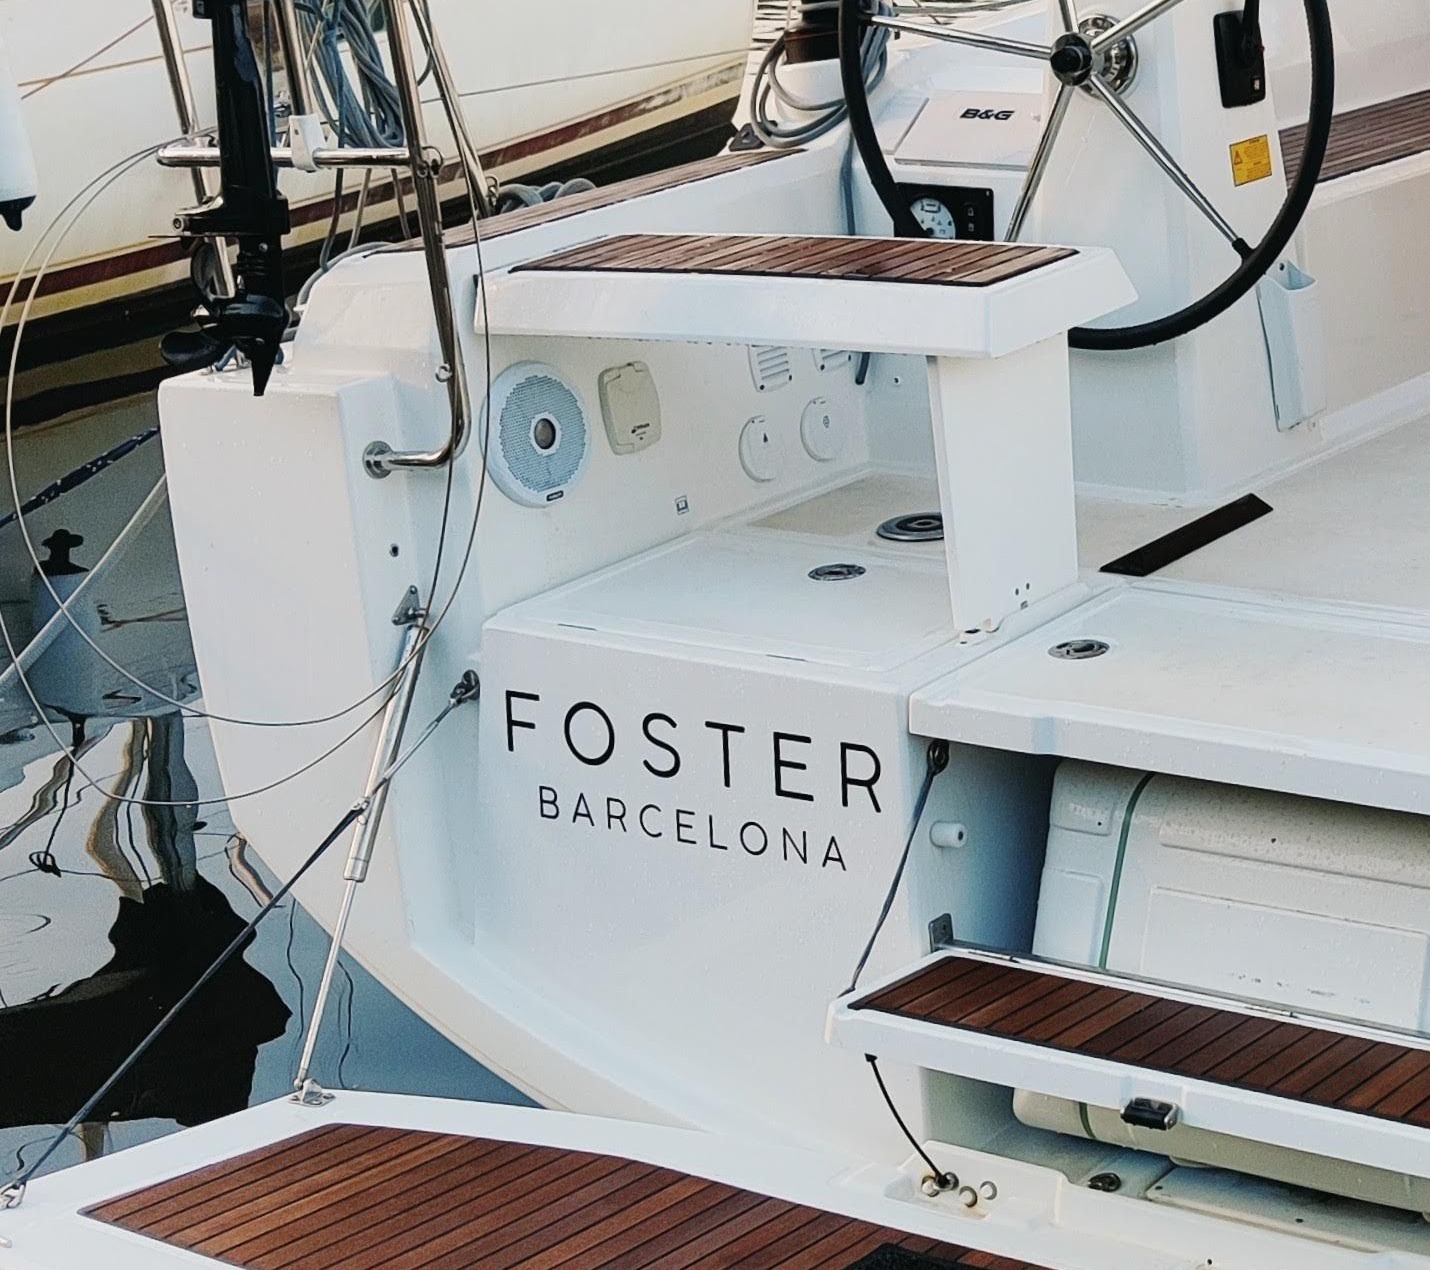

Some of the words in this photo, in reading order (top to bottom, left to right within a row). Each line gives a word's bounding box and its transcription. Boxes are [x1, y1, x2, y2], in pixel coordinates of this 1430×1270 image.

[960, 108, 1015, 120] B&G
[505, 689, 882, 813] FOSTER
[538, 785, 847, 871] BARCELONA
